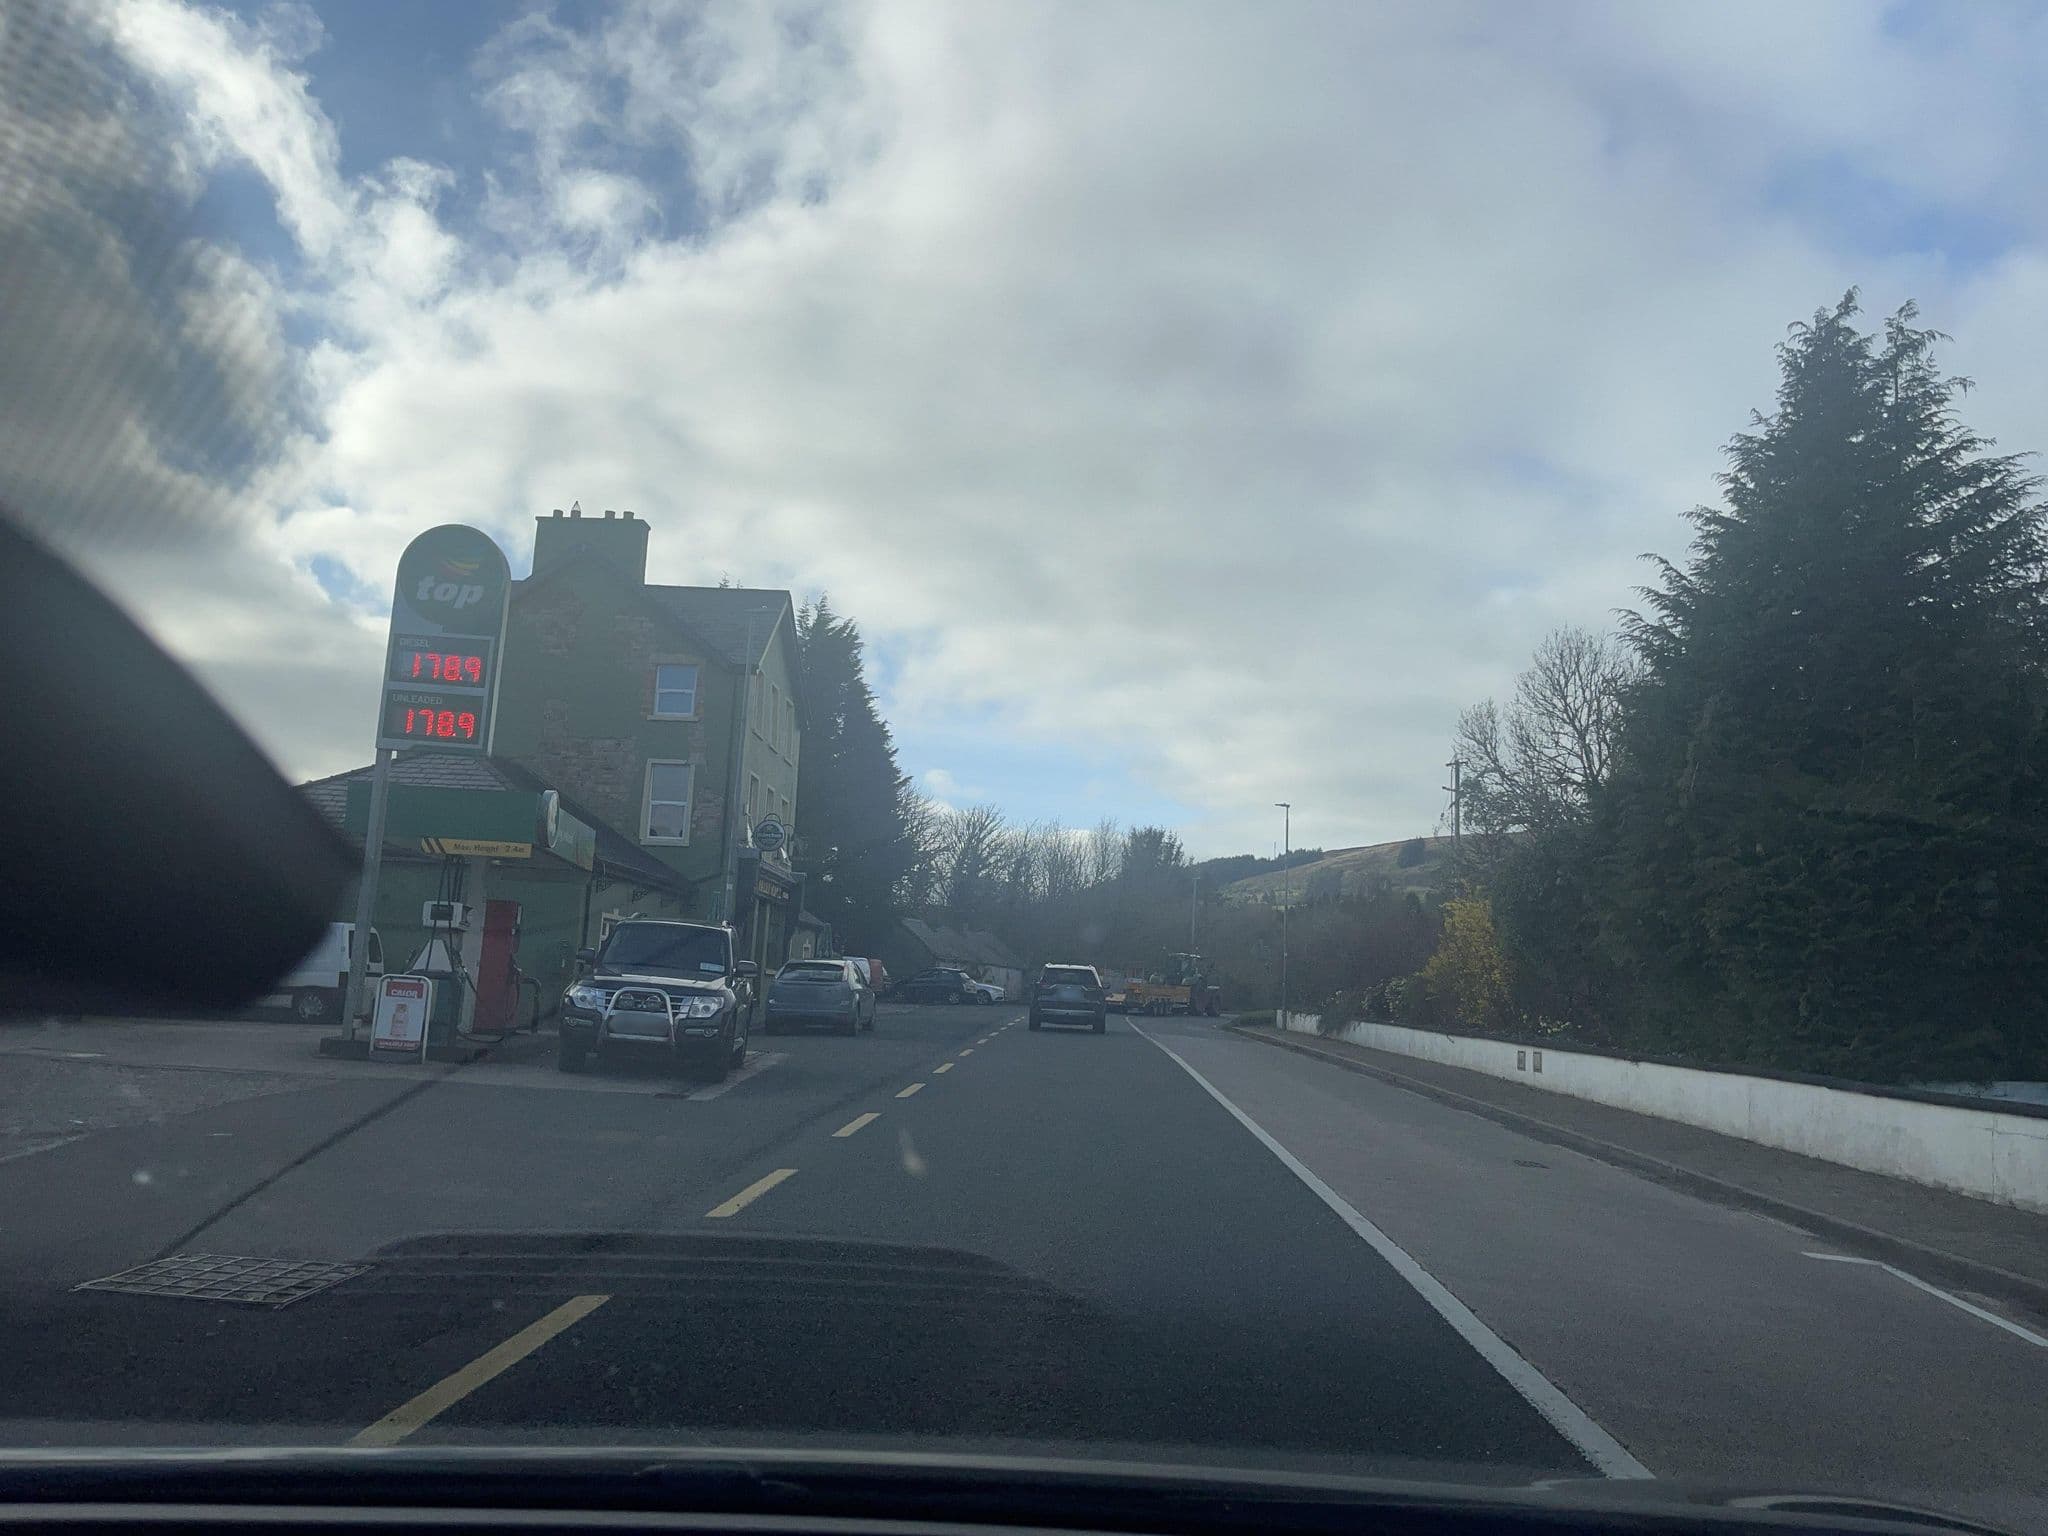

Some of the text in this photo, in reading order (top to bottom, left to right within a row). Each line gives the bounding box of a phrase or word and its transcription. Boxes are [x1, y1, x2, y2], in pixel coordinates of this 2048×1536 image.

[416, 575, 484, 609] top
[411, 651, 482, 683] 178.9
[392, 692, 443, 706] UNLEADED
[405, 708, 476, 740] 178.9
